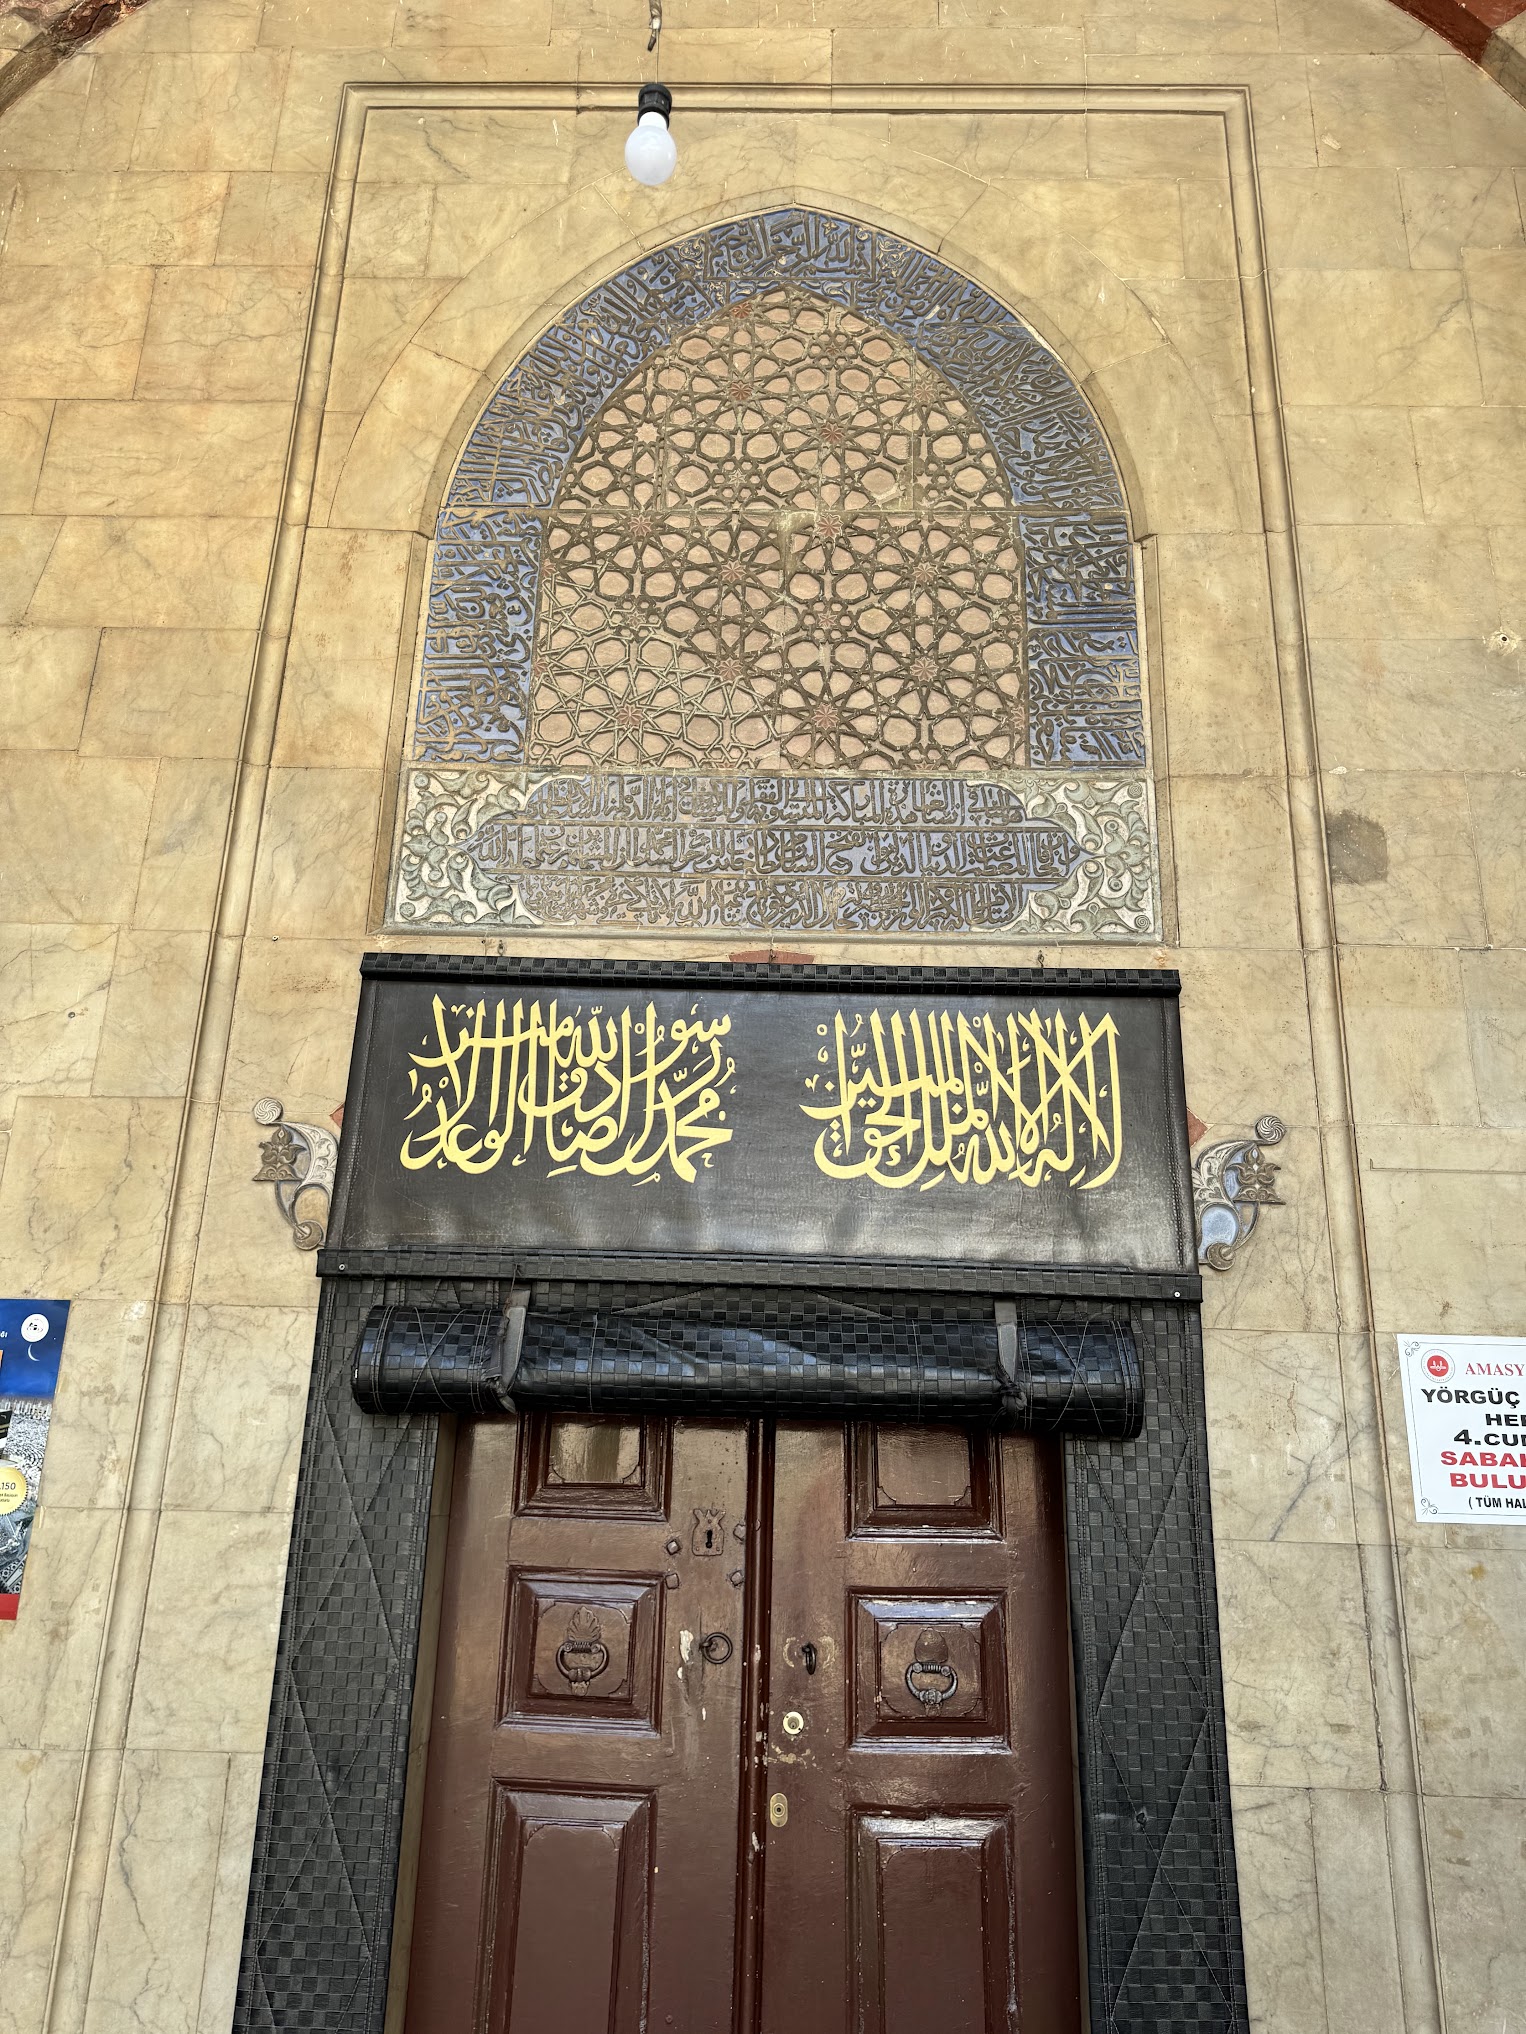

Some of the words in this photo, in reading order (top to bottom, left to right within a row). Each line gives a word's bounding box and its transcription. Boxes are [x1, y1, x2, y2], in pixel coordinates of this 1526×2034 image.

[1465, 1362, 1525, 1377] AMASY
[1421, 1386, 1520, 1409] YÖRGÜÇ
[1475, 1495, 1502, 1509] TÜM
